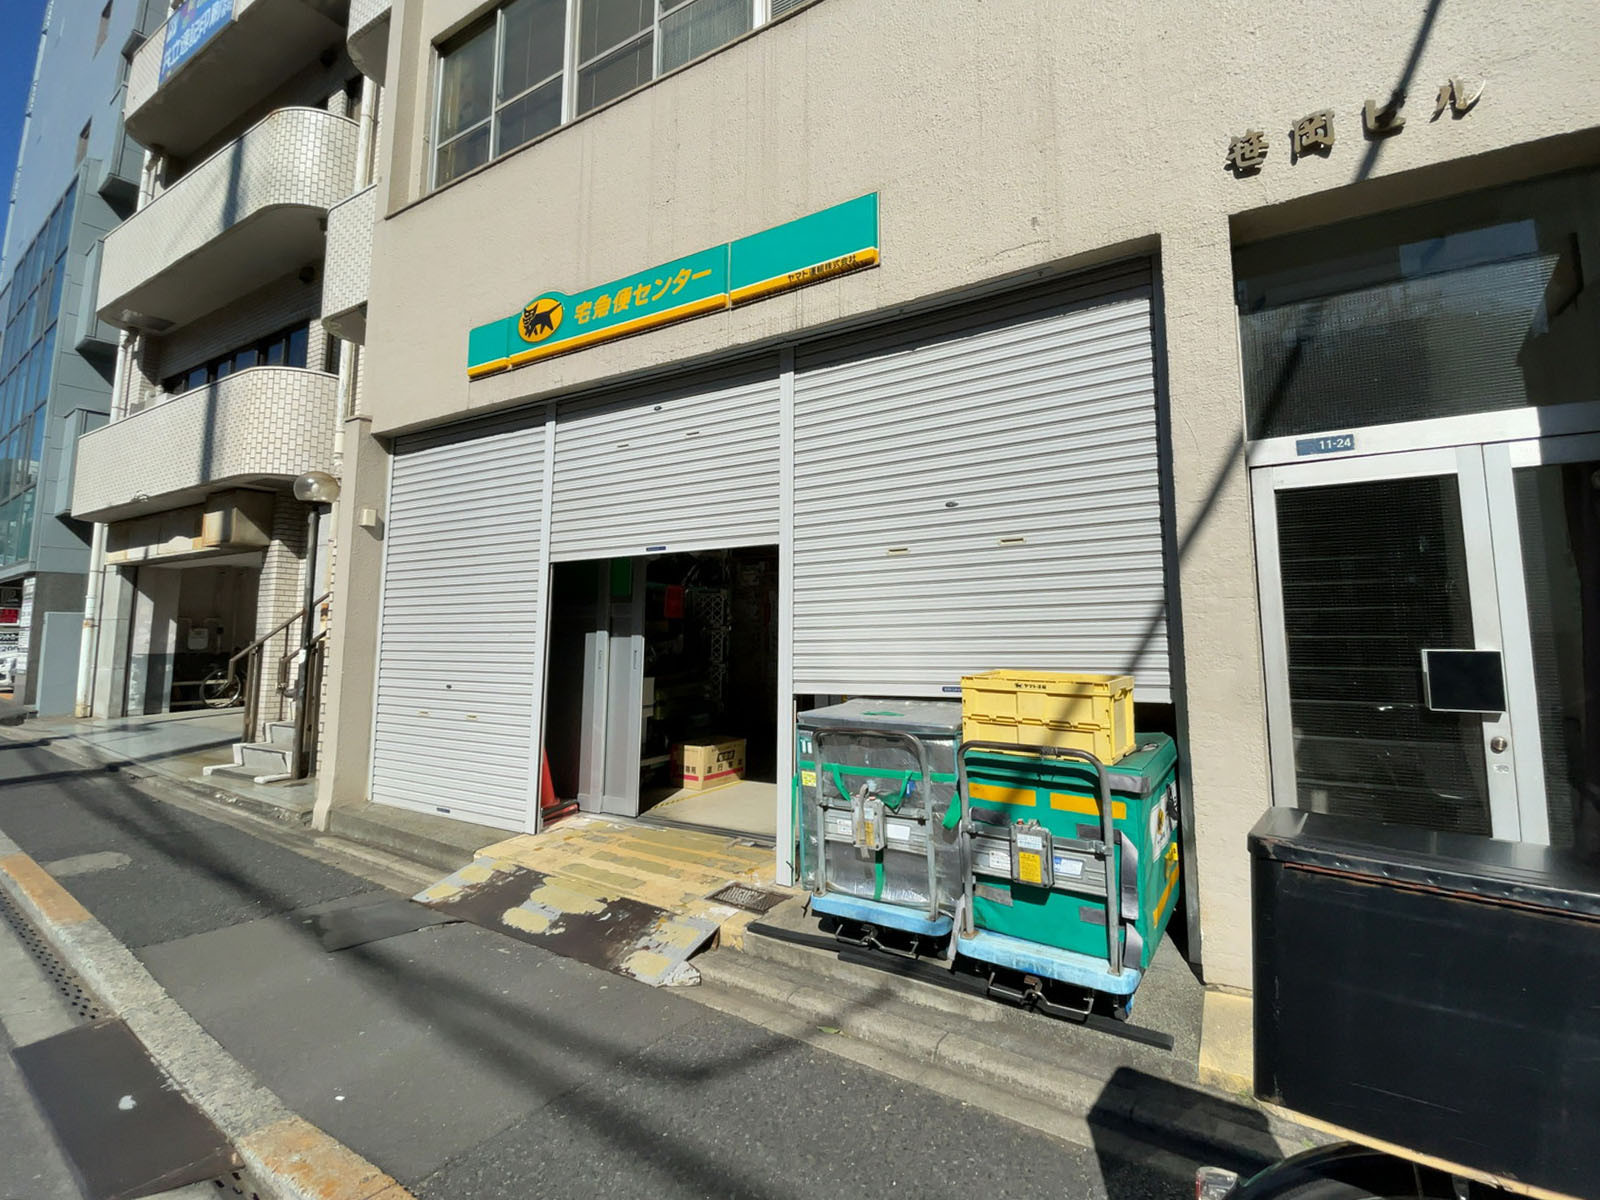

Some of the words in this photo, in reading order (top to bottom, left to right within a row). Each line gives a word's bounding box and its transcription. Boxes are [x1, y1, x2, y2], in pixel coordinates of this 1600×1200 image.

[574, 268, 712, 324] 宅急便センター
[1320, 438, 1351, 449] 11-24
